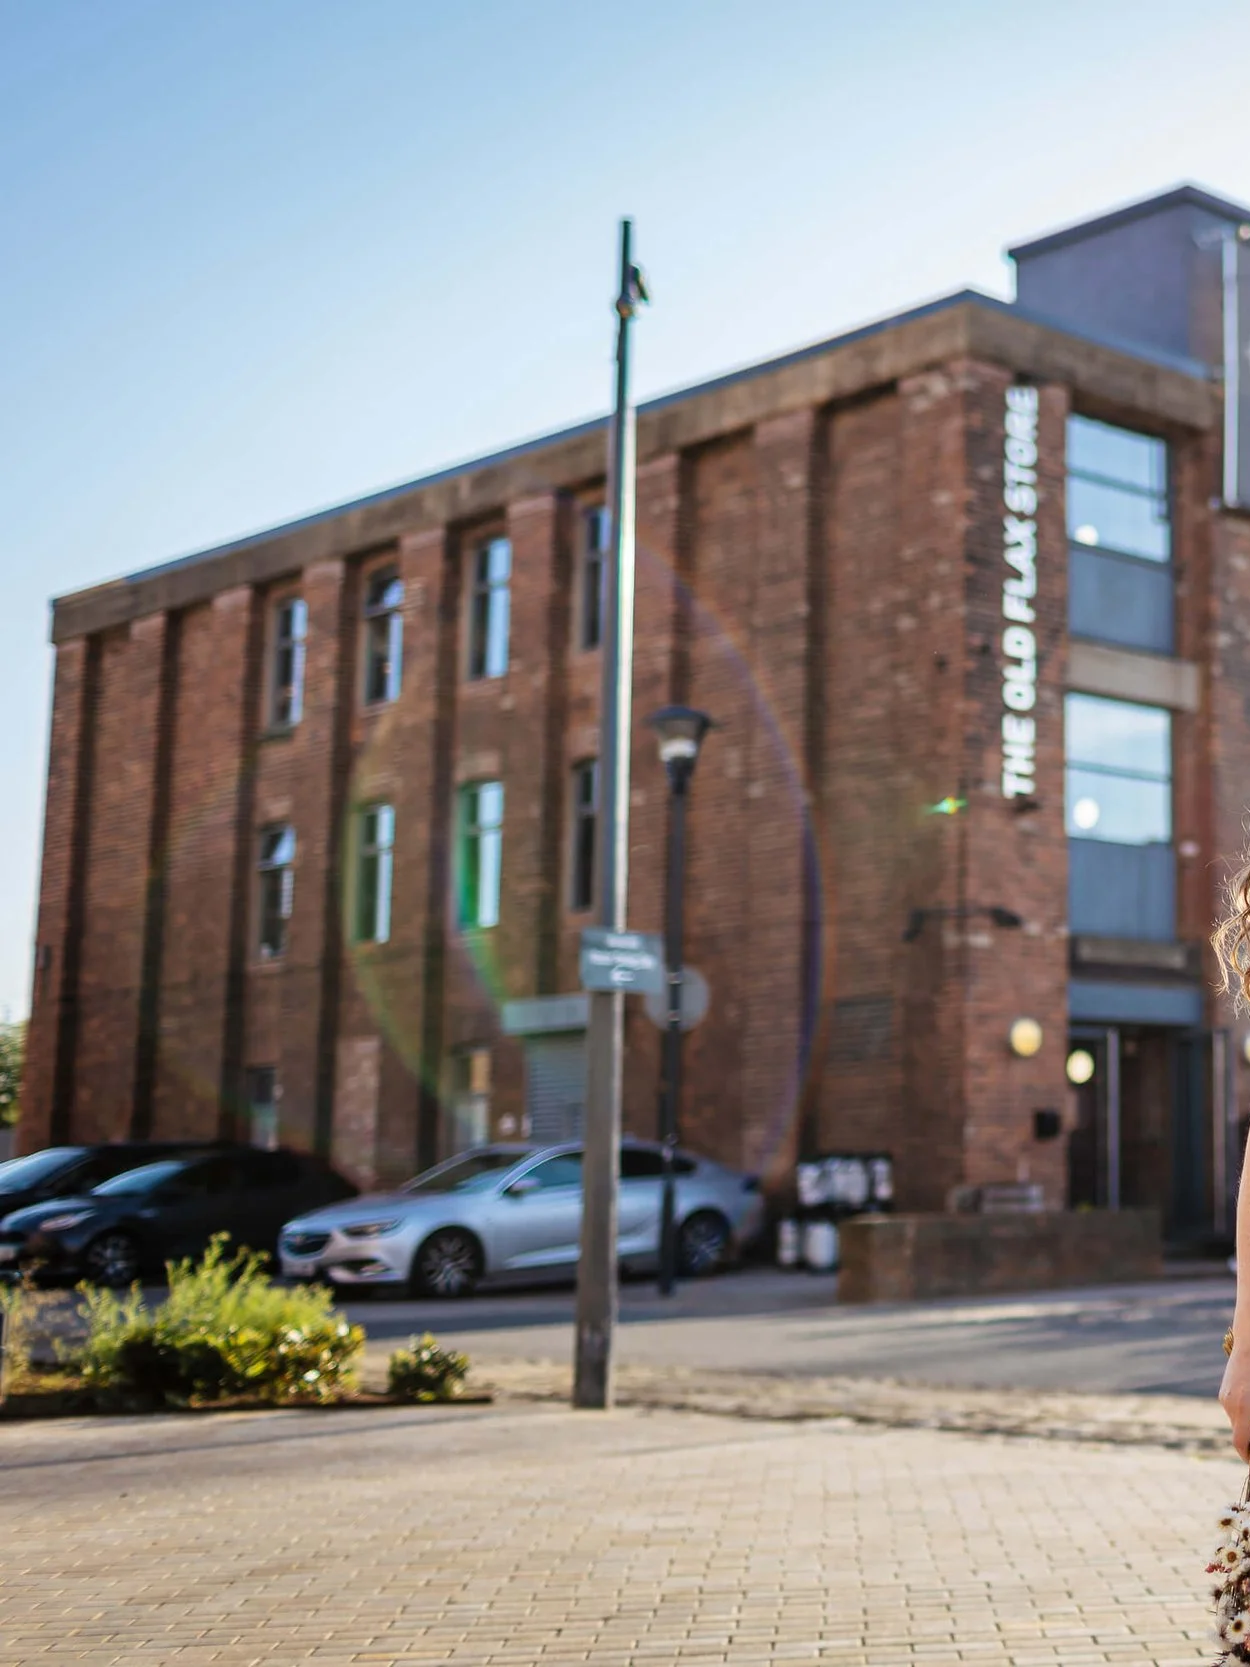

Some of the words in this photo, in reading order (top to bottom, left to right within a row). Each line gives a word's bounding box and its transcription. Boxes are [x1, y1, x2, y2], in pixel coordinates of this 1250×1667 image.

[1004, 386, 1039, 515] STORE
[1003, 514, 1038, 624] FLAX
[1002, 625, 1037, 711] OLD
[1002, 713, 1037, 800] THE
